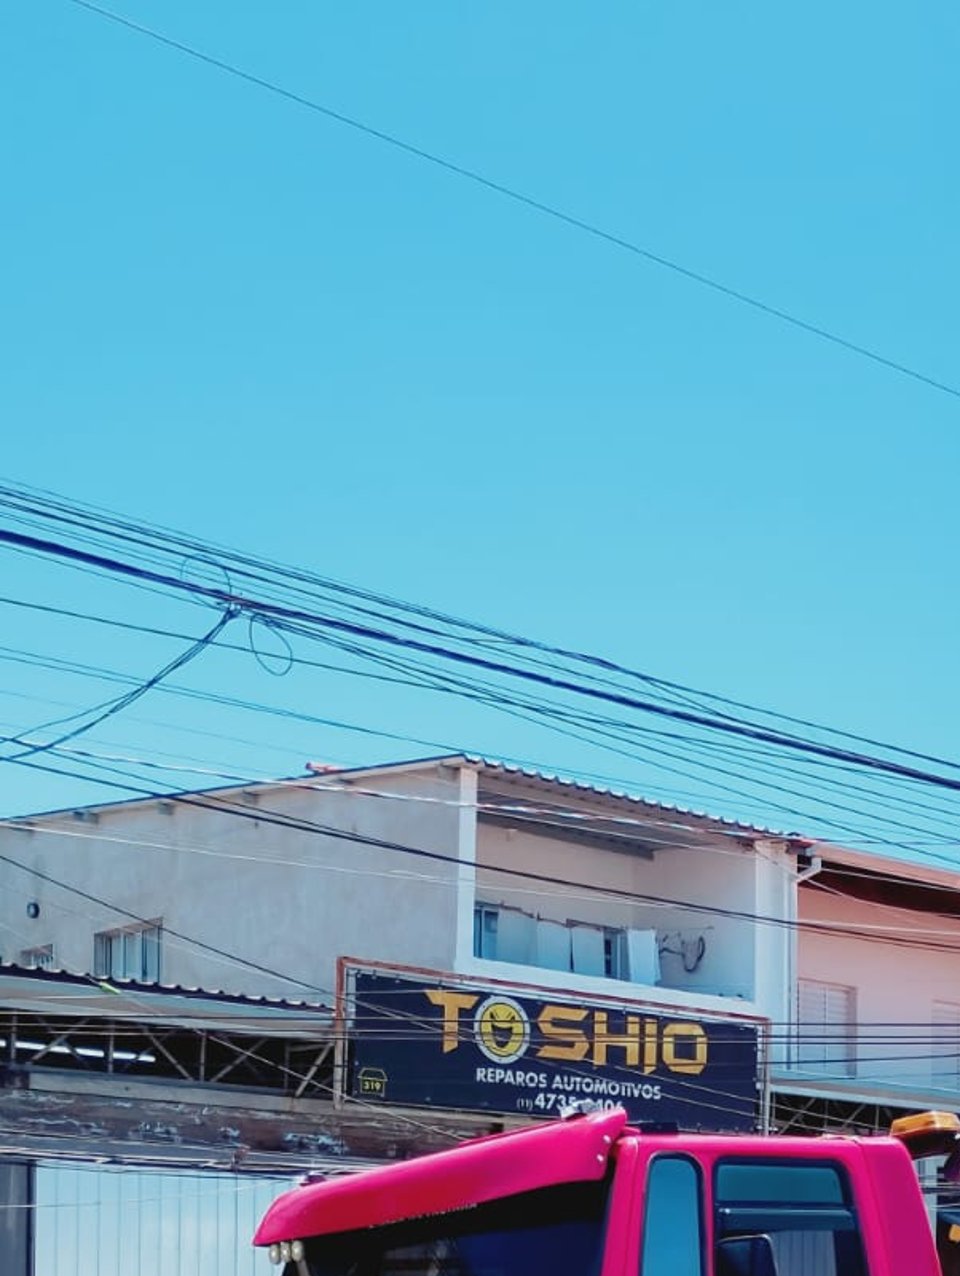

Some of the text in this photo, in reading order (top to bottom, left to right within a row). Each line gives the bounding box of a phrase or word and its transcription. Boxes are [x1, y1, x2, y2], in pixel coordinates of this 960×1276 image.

[425, 989, 708, 1075] TOSHIO
[475, 1067, 662, 1100] REPAROS AUTOMOTIVOS
[516, 1097, 534, 1112] (11)
